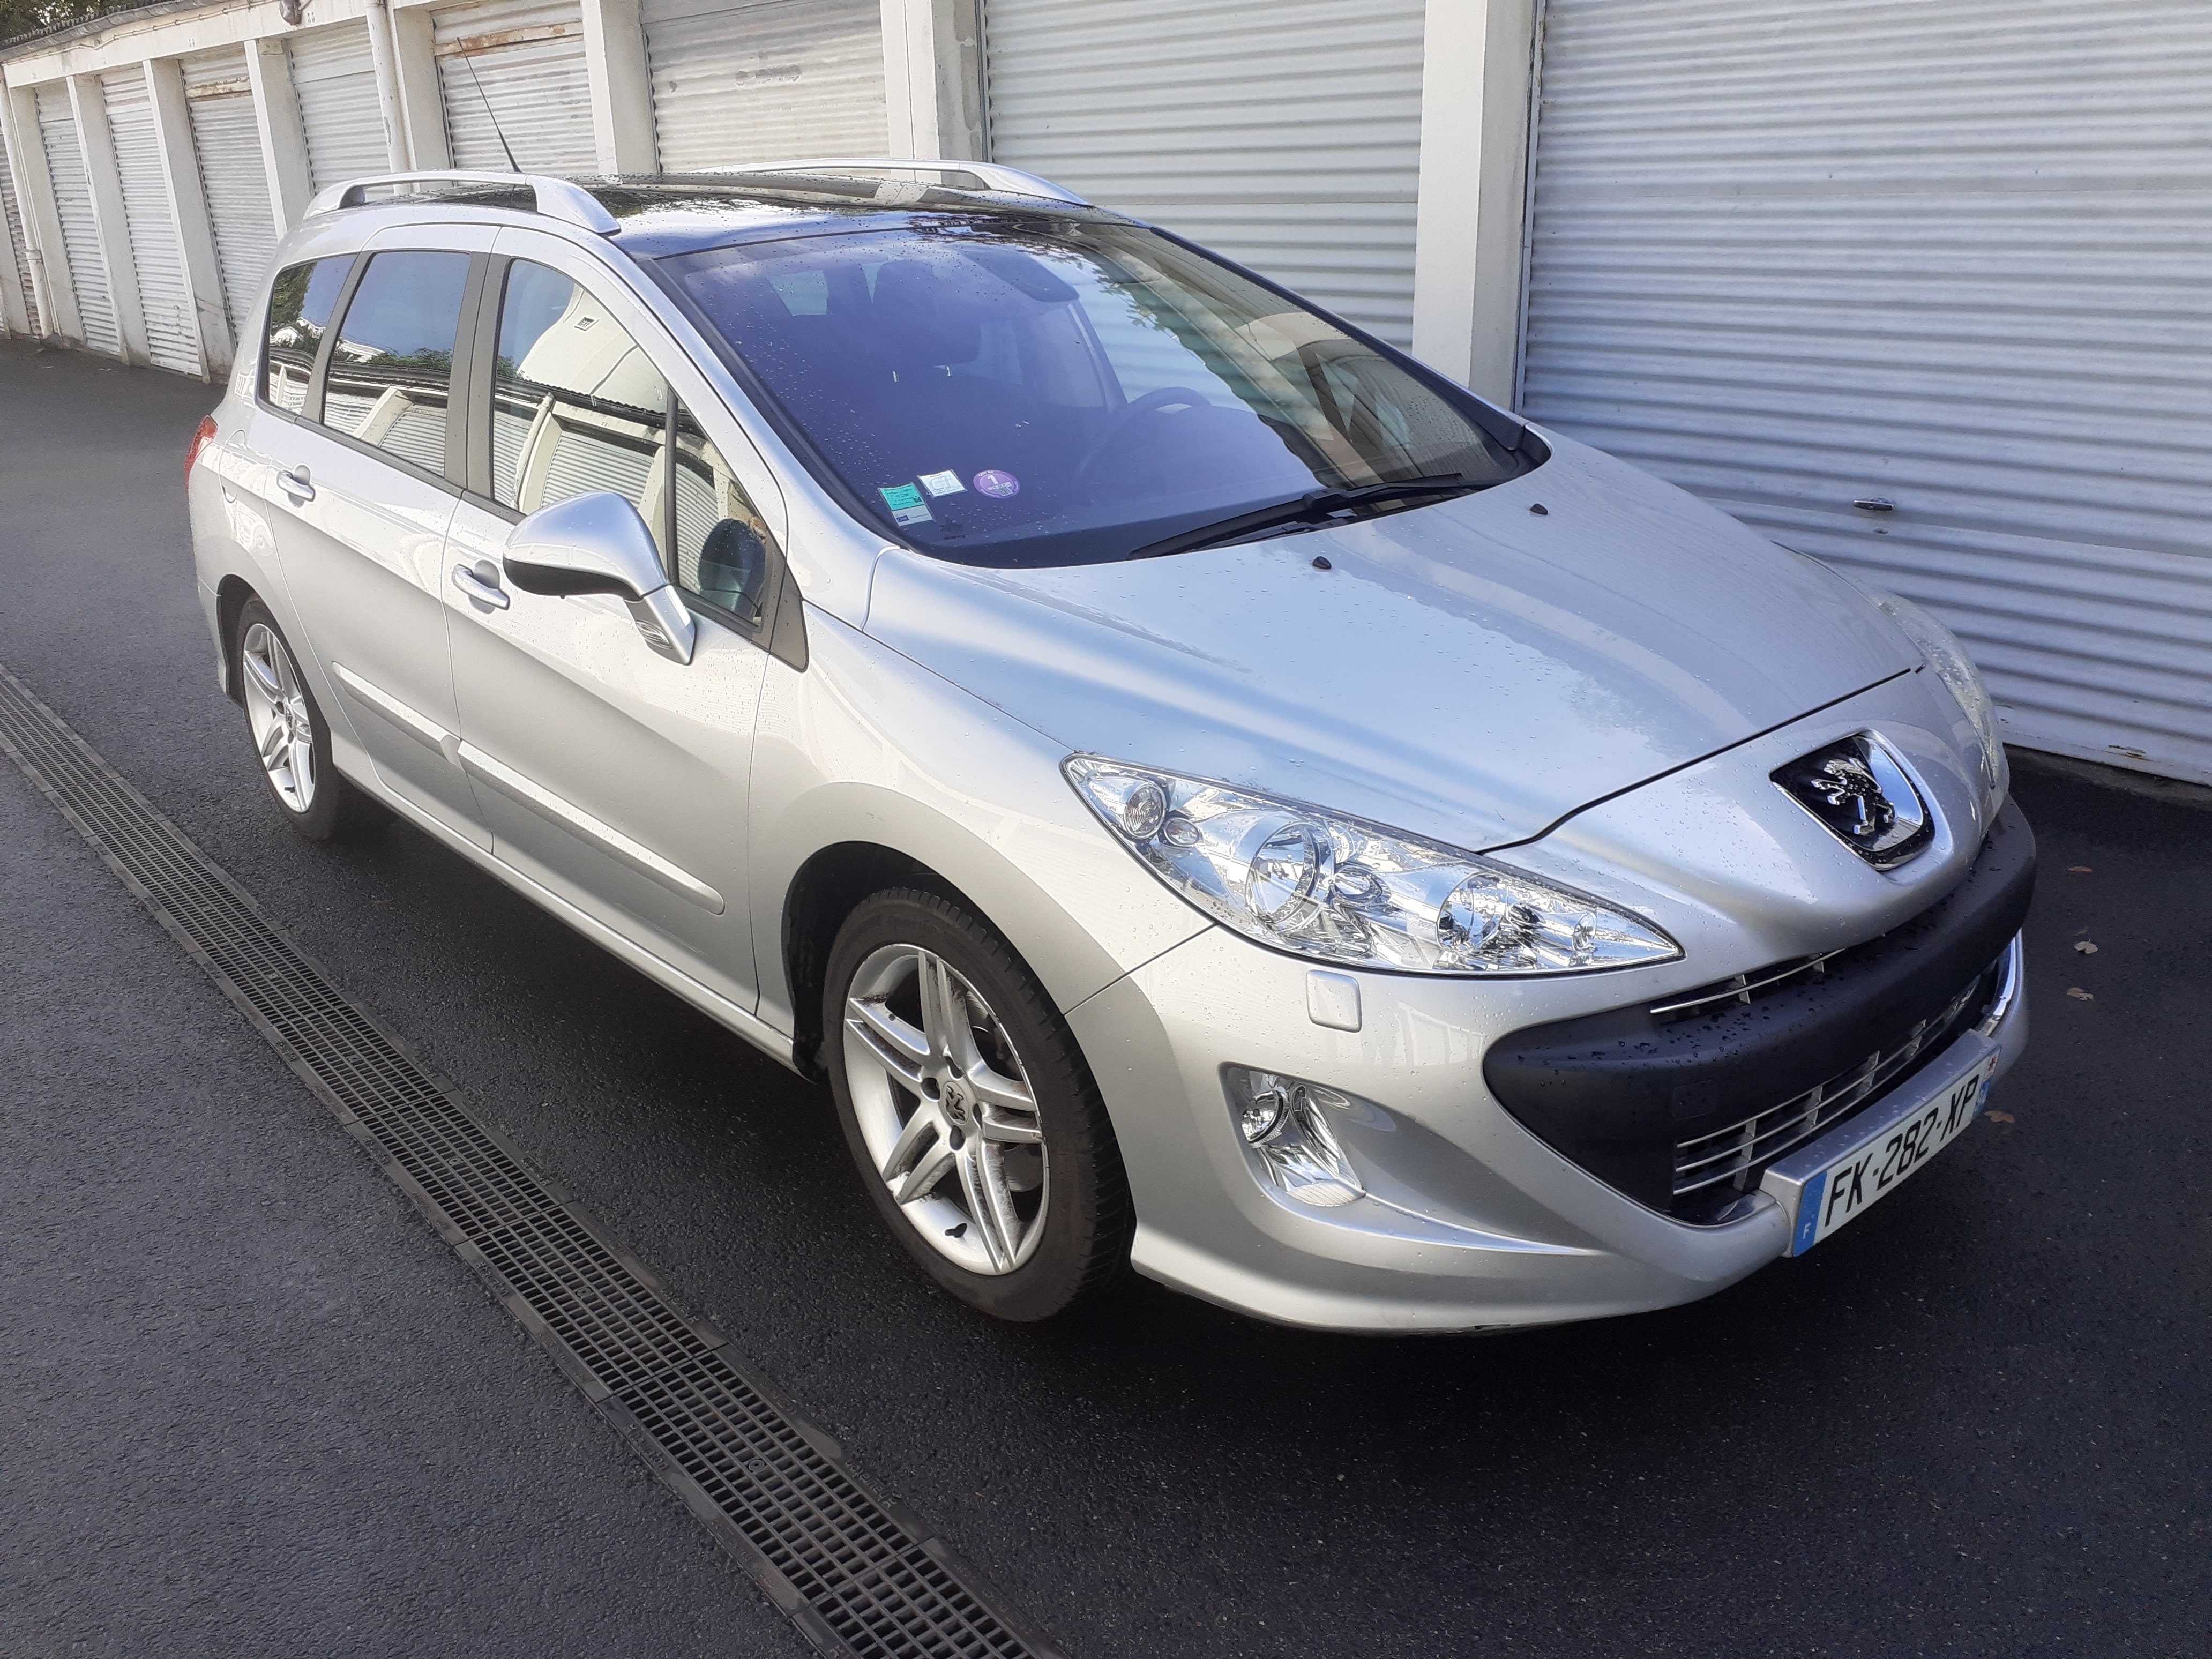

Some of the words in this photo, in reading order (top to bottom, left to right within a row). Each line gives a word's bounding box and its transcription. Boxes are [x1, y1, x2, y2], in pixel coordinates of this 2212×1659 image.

[987, 475, 999, 485] 1
[1825, 1074, 1979, 1228] FK-282-XP
[1802, 1222, 1811, 1239] F
